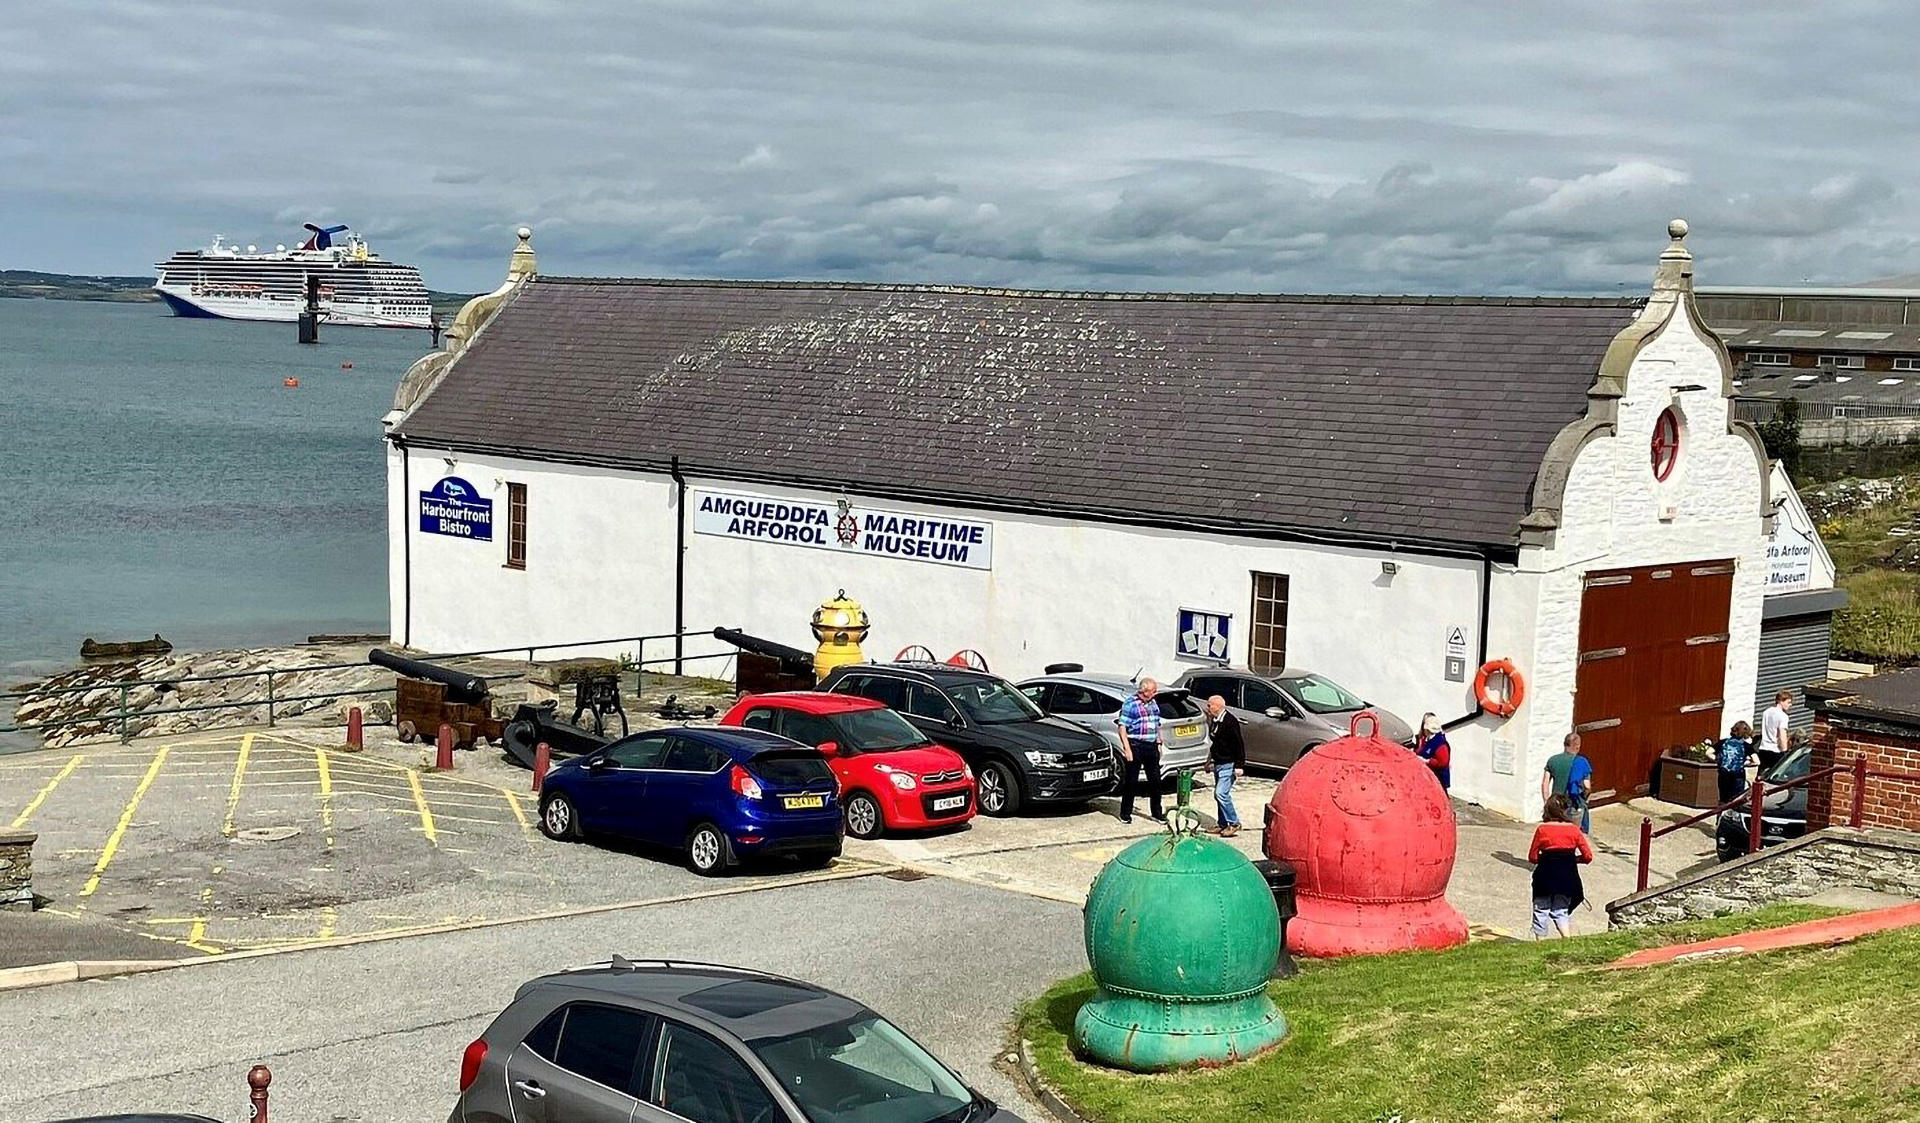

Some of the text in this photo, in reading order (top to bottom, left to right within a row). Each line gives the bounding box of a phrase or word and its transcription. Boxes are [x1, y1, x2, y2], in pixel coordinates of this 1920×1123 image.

[422, 501, 490, 523] Harbourfront
[448, 497, 462, 507] The
[699, 496, 829, 526] AMGUEDDFA
[439, 518, 471, 536] Bistro
[727, 518, 827, 545] ARFOROL
[864, 514, 985, 544] MARITIME
[864, 534, 969, 563] MUSEUM
[1771, 572, 1806, 584] Museum
